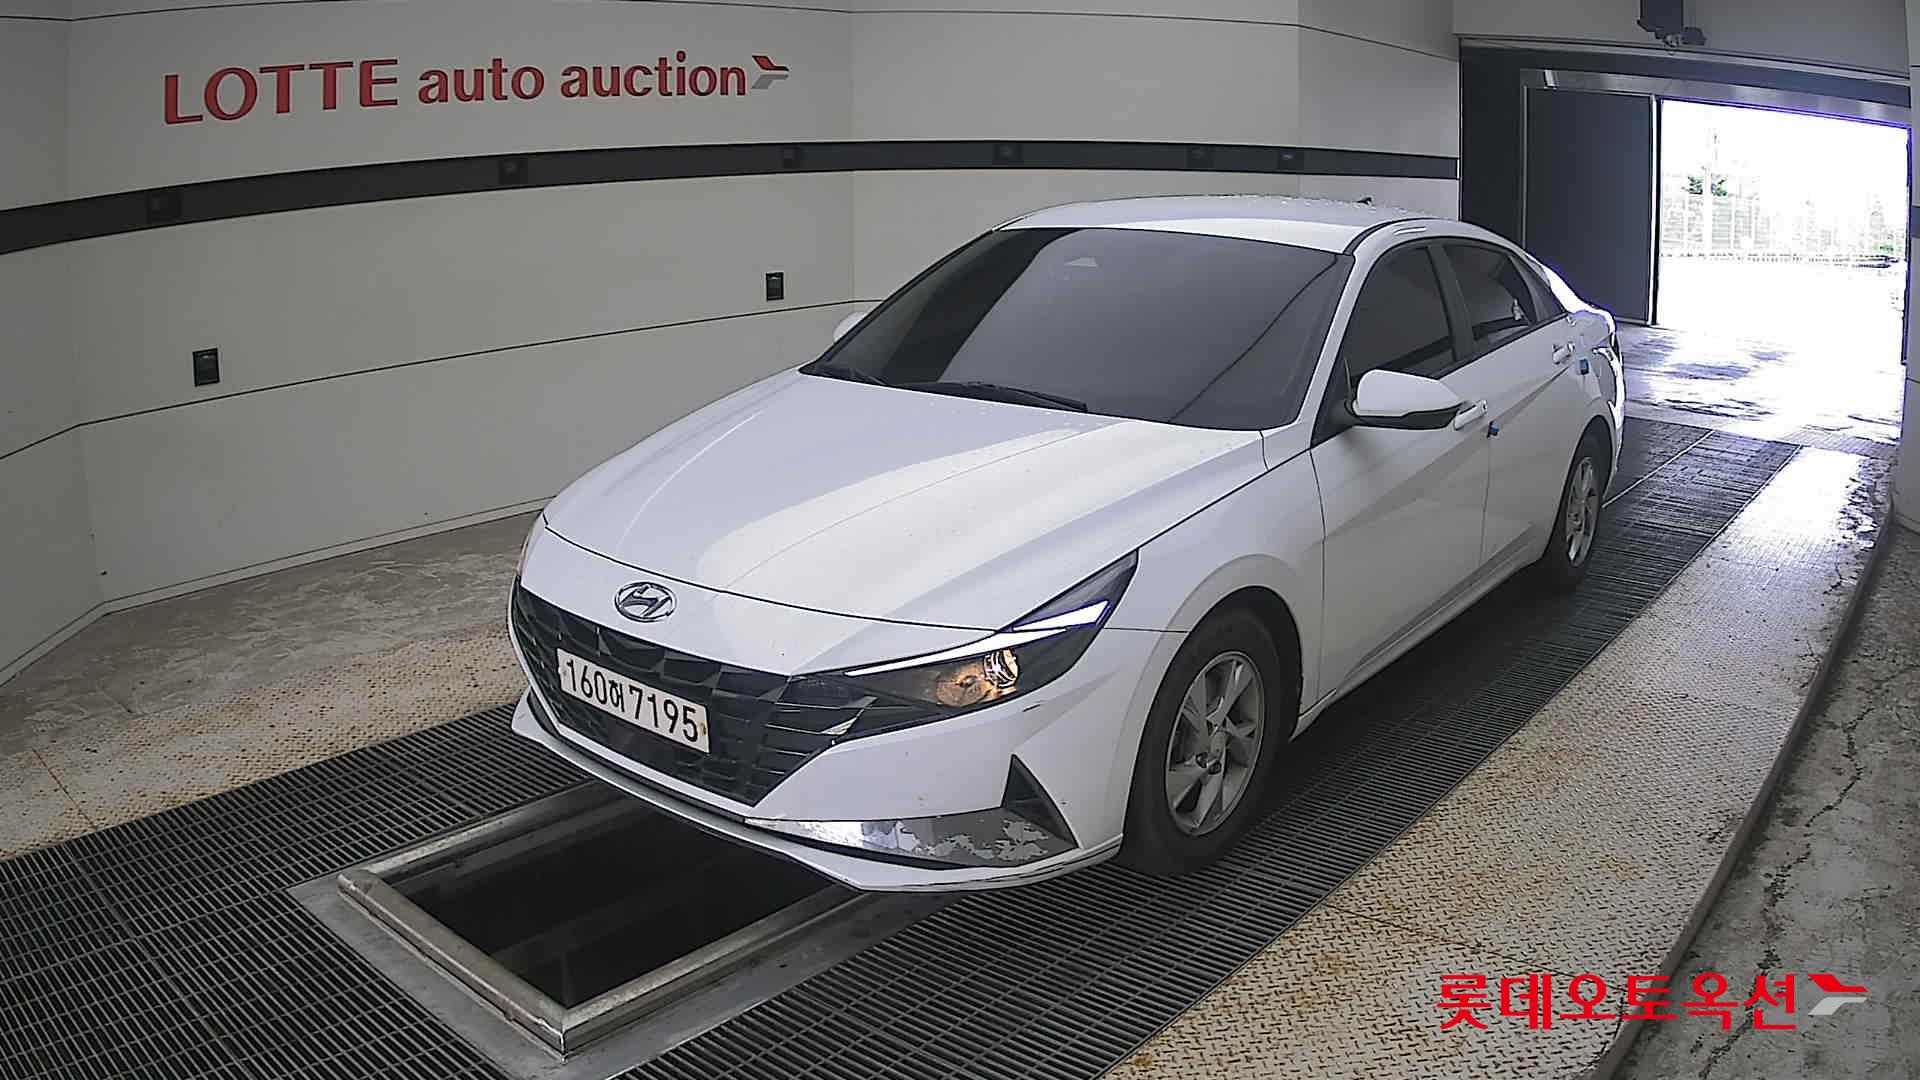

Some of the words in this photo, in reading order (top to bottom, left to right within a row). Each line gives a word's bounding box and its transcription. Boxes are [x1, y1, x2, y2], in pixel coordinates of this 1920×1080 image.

[164, 58, 399, 124] LOTTE
[418, 57, 545, 103] auto
[560, 51, 747, 98] auction
